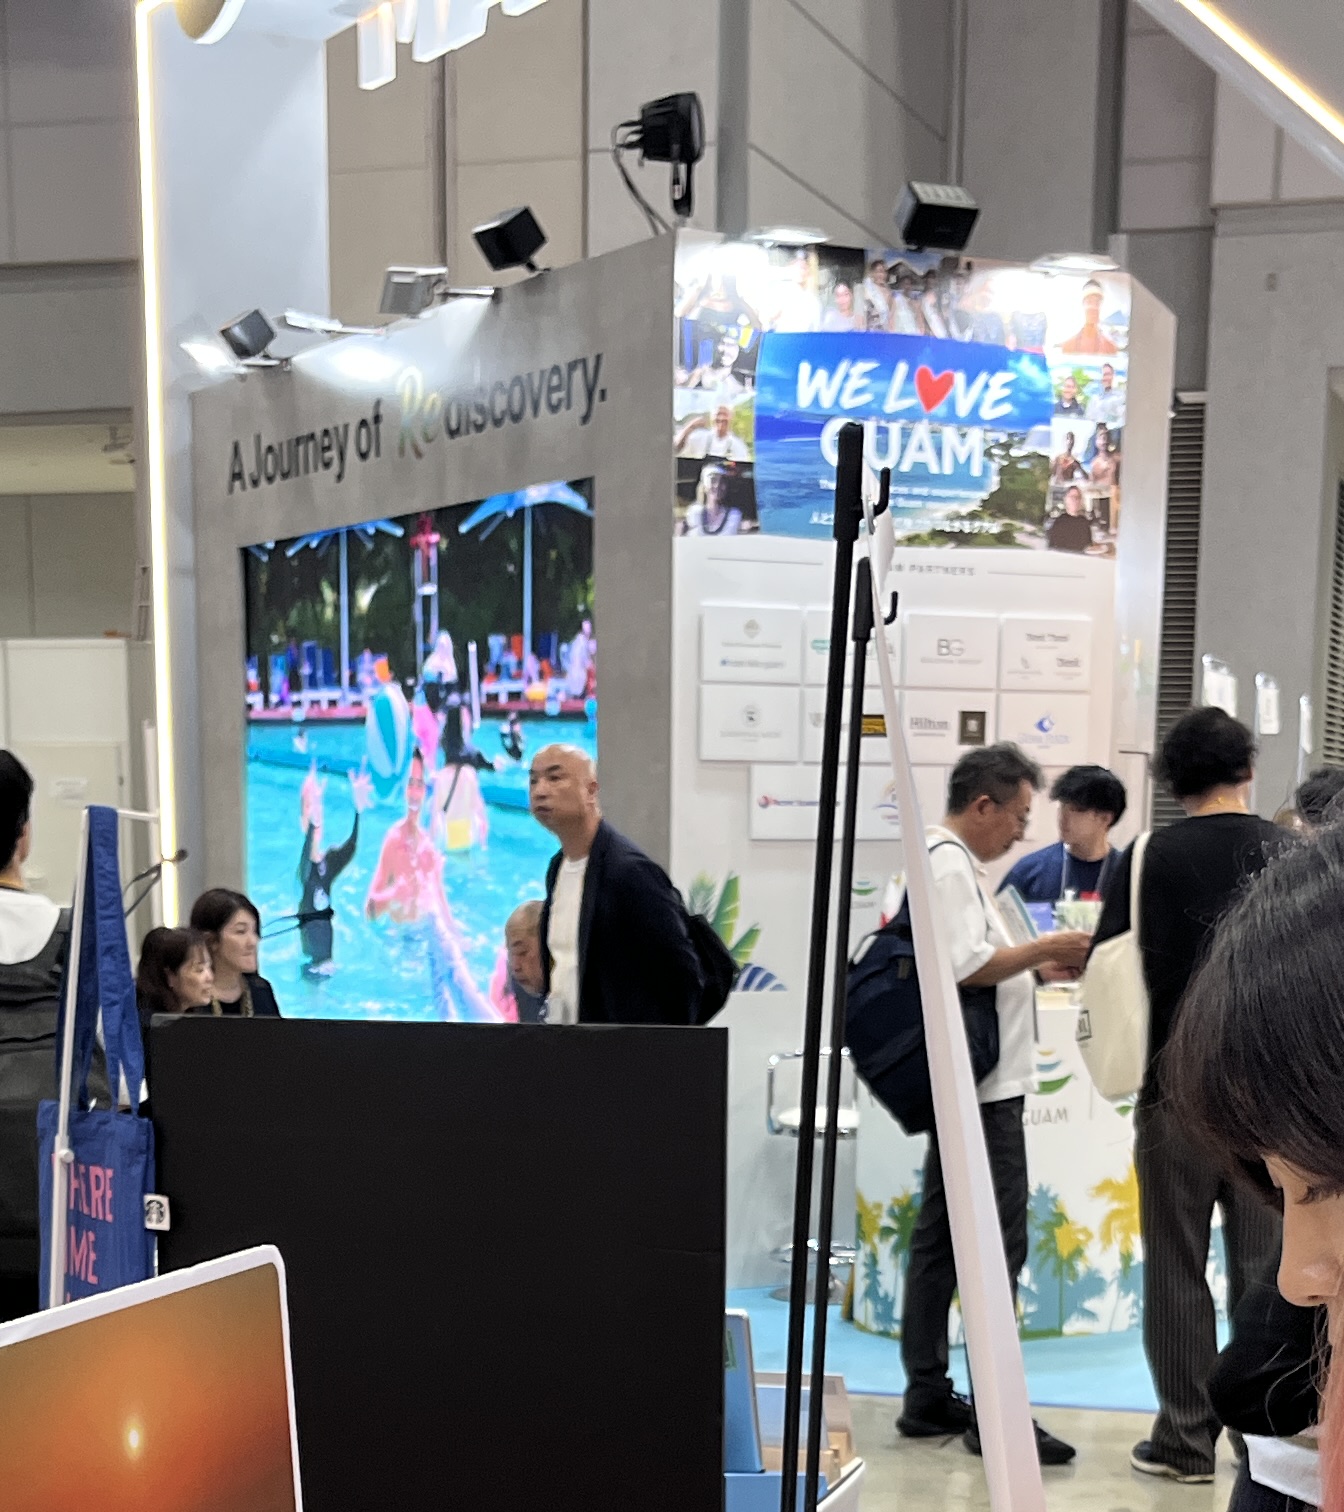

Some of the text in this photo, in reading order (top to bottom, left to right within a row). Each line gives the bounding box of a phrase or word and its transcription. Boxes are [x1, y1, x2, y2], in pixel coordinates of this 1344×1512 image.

[797, 358, 880, 410] WE
[227, 440, 247, 495] A
[250, 422, 351, 488] Journey
[356, 399, 383, 461] of
[51, 1153, 114, 1224] HERE
